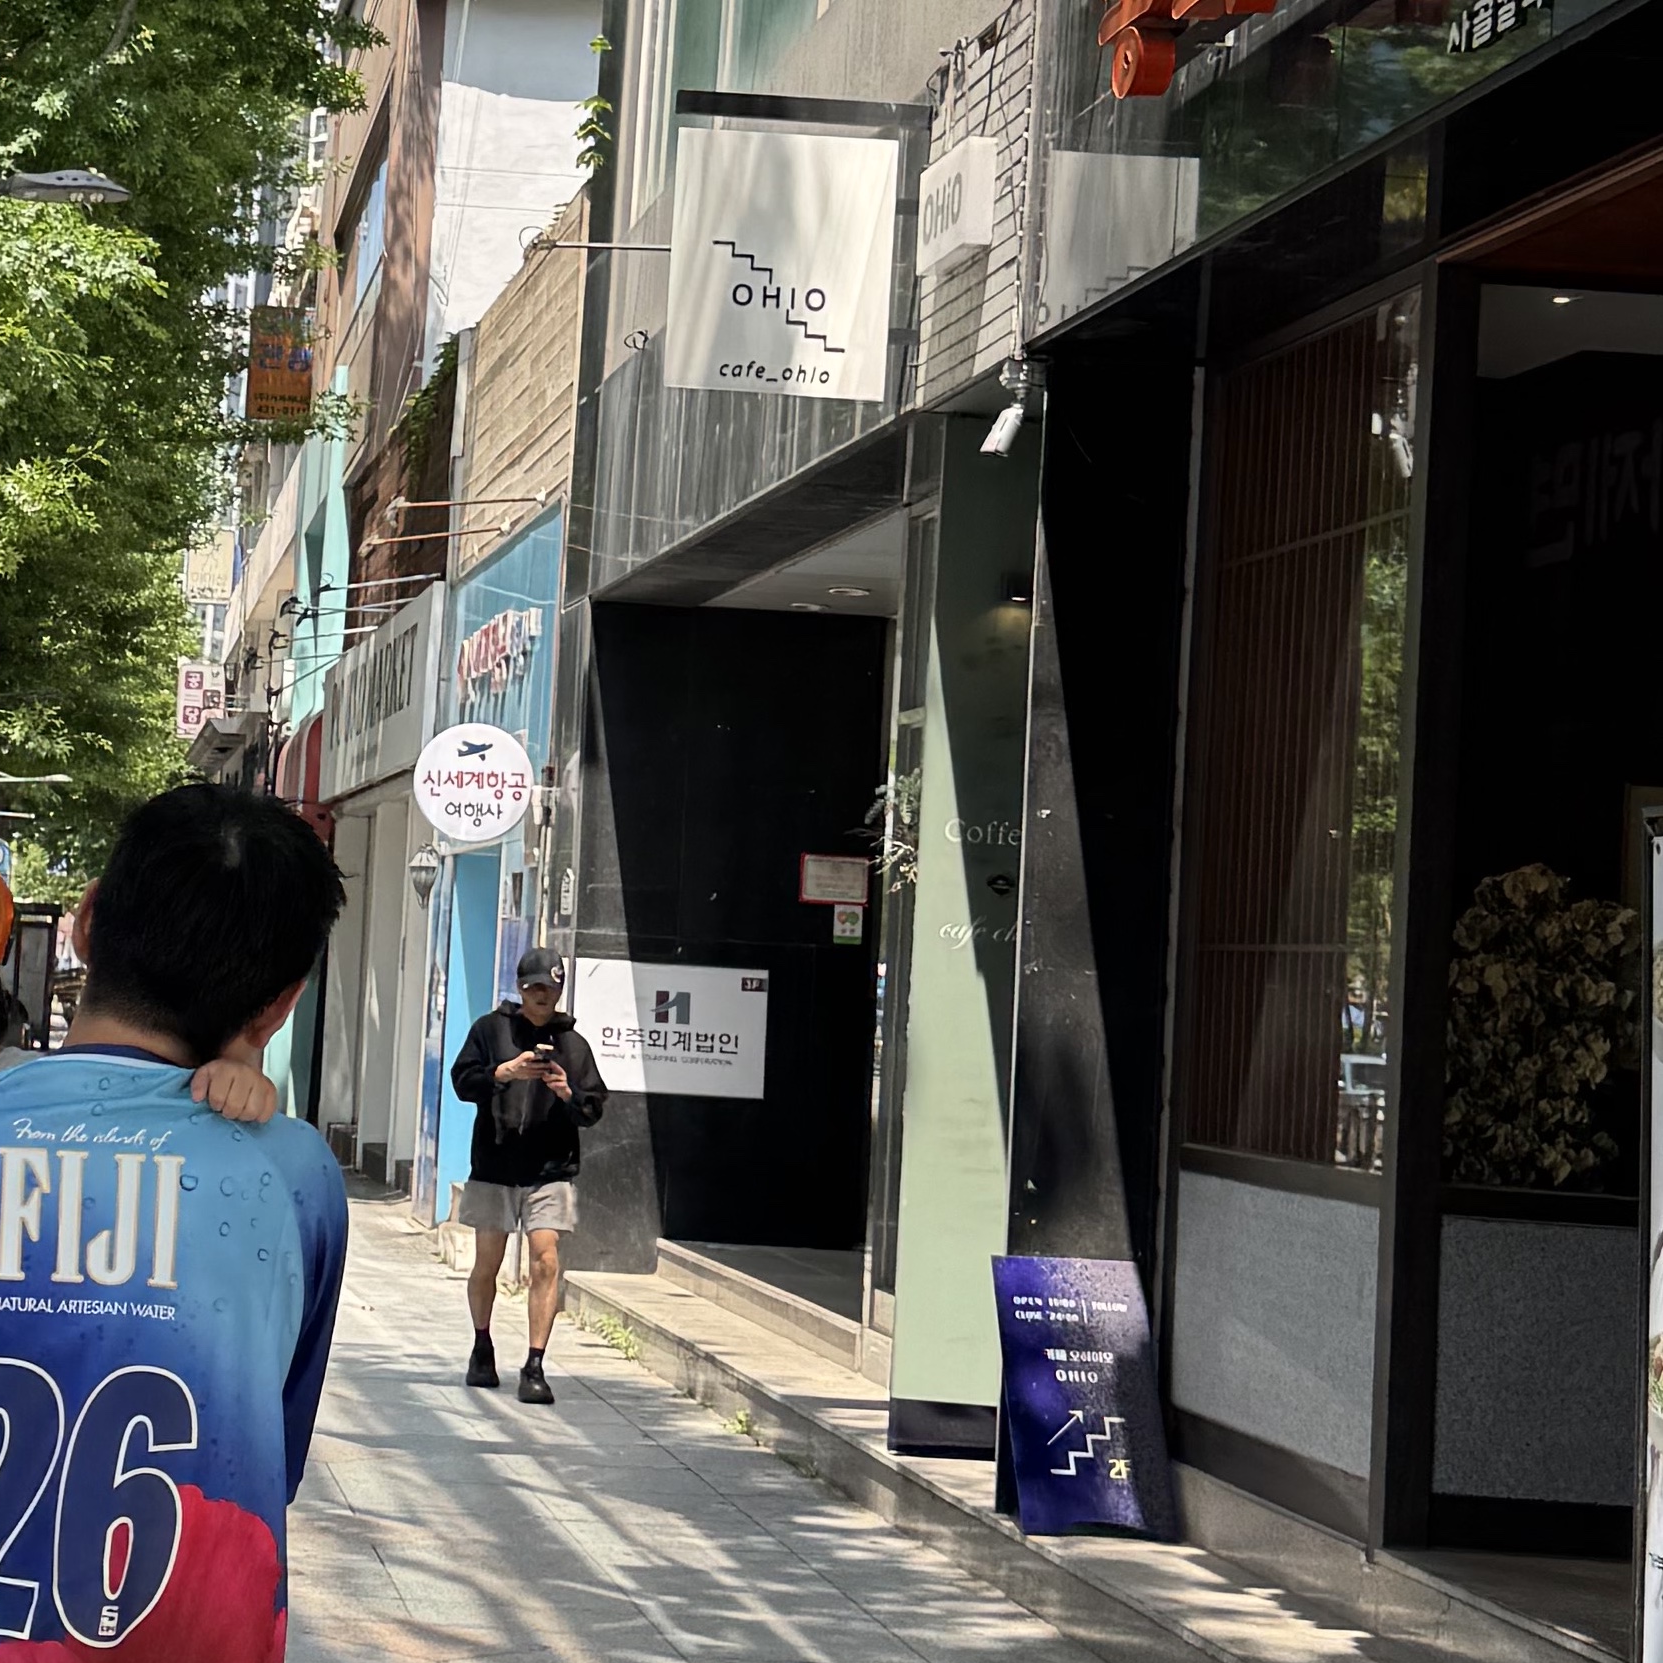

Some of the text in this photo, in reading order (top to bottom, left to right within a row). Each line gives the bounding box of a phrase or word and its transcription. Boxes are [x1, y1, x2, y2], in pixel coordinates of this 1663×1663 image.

[732, 283, 825, 312] OHIO
[422, 769, 528, 801] 신세계항공
[444, 801, 503, 827] 여행사
[13, 1118, 173, 1151] From the islands of
[56, 1299, 128, 1316] ARTESIAN
[129, 1302, 176, 1321] WATER
